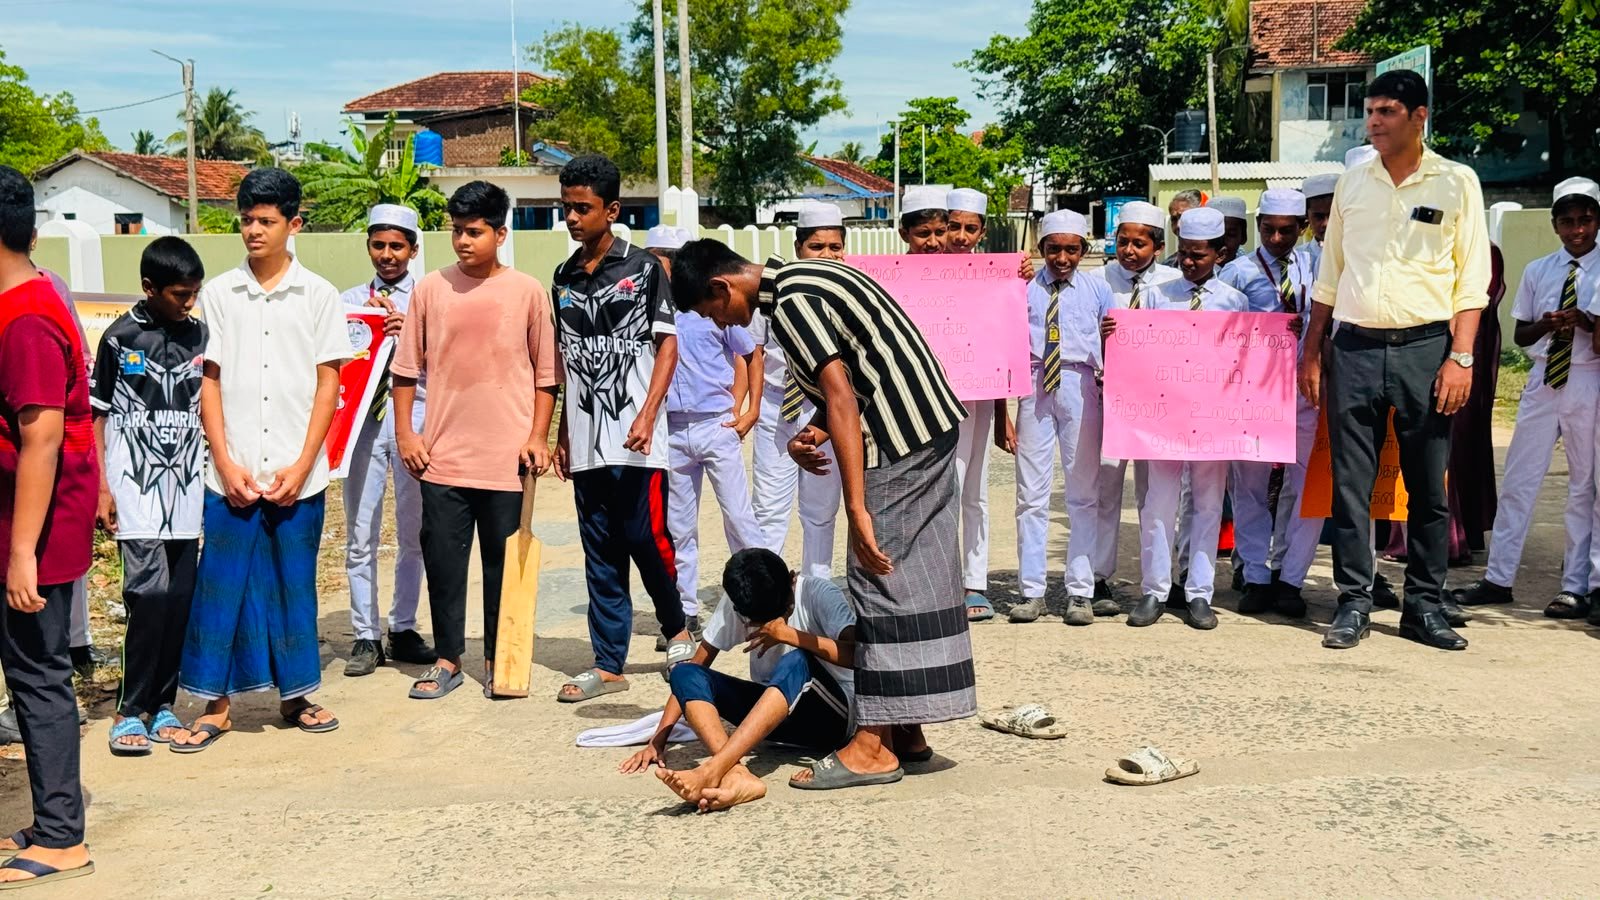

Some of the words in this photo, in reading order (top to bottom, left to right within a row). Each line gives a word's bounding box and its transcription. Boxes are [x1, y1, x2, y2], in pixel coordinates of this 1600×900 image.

[112, 409, 150, 432] DARK
[154, 409, 202, 429] WARRIO
[160, 427, 178, 445] SC
